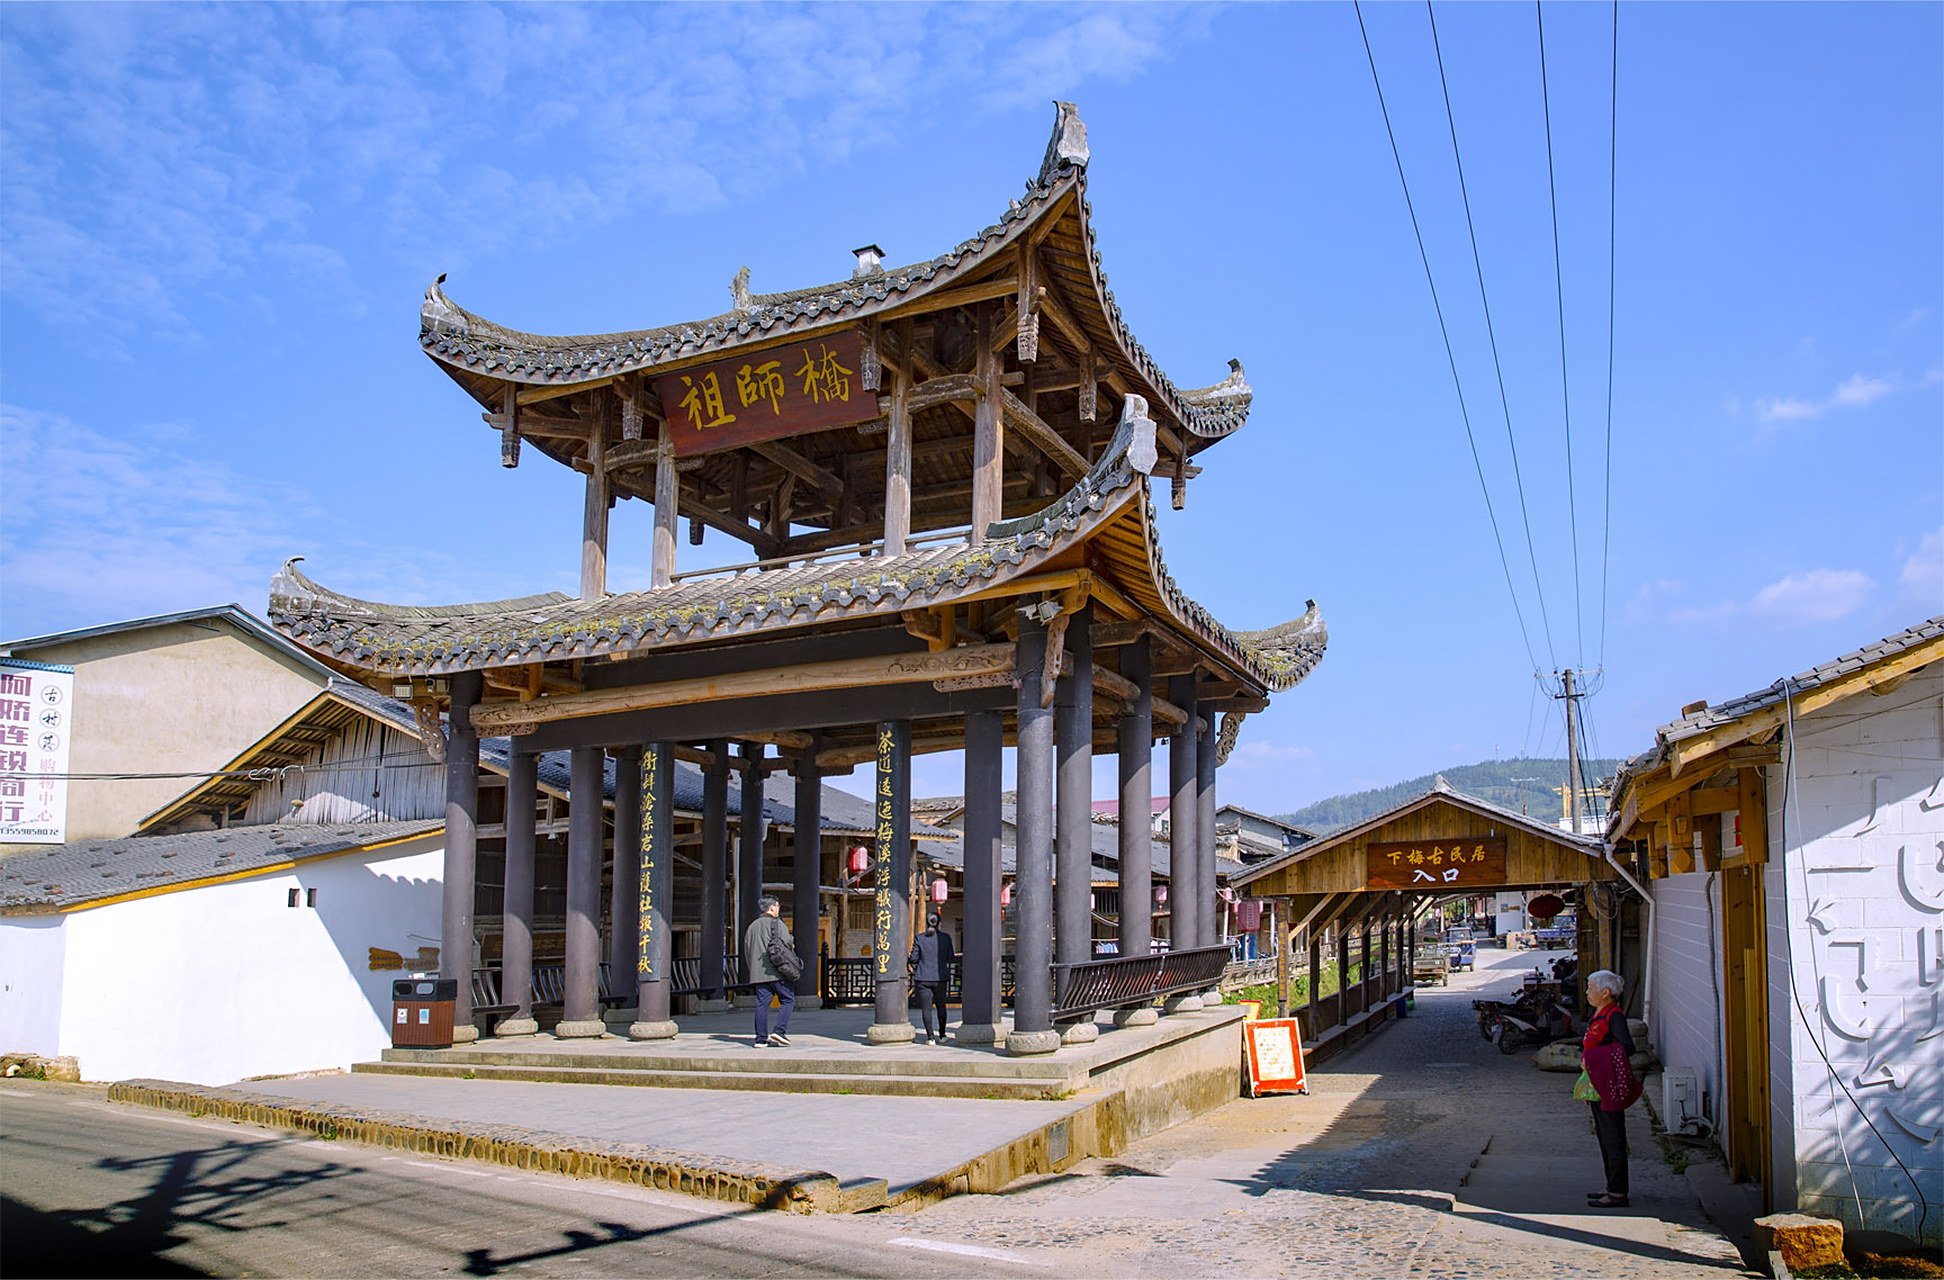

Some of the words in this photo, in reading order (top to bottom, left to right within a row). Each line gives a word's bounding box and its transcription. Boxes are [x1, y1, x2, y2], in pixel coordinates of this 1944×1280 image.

[678, 343, 854, 431] 祖師橋
[37, 758, 57, 822] 购物中心
[1386, 844, 1486, 866] 下梅古民居
[1412, 868, 1460, 883] 入口
